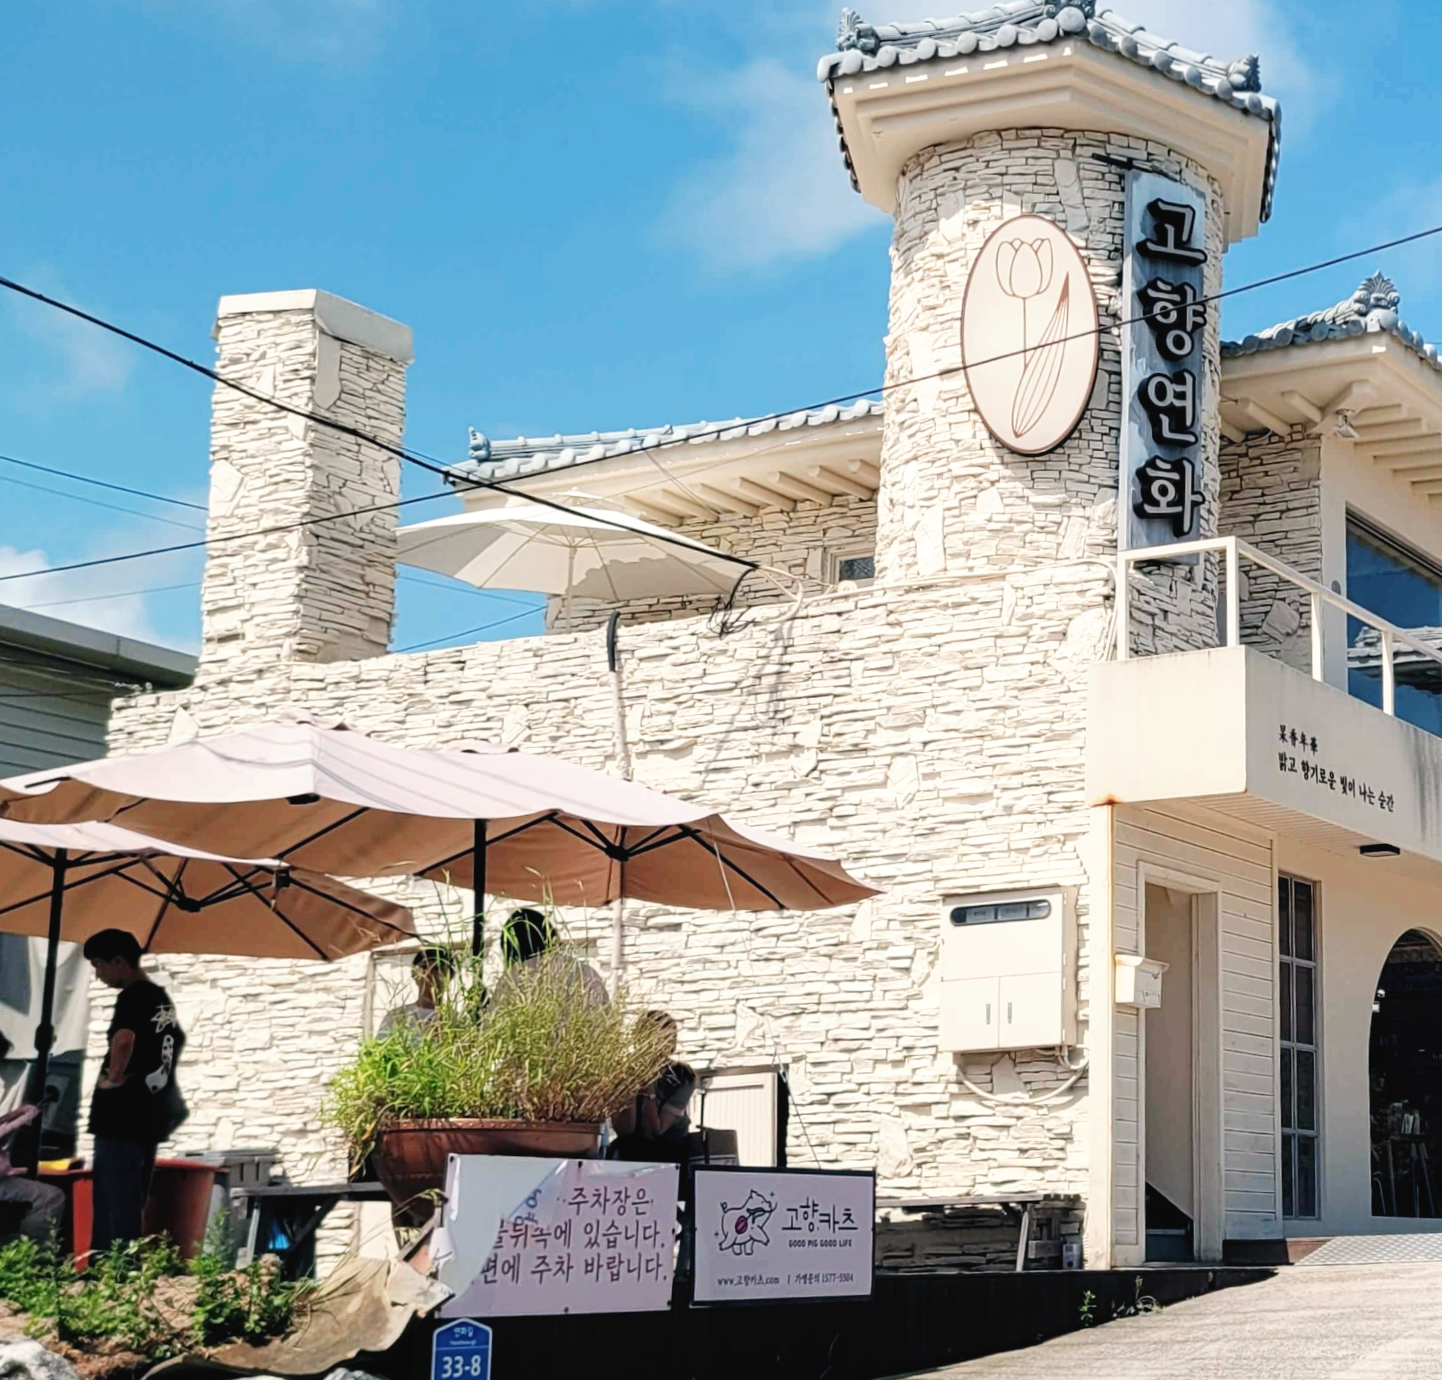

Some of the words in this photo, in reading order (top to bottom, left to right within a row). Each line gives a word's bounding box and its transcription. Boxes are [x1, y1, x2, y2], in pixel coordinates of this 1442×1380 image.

[1136, 196, 1208, 537] 고향연화
[1278, 751, 1298, 773] 밝고
[1301, 759, 1337, 790] 향기로운
[1340, 775, 1356, 798] 빛이
[1359, 782, 1376, 806] 나는
[1378, 790, 1395, 813] 순간
[568, 1186, 650, 1216] 주차장은
[583, 1218, 665, 1249] 있습니다.
[788, 1239, 806, 1248] GOOD
[807, 1239, 818, 1248] PIG
[820, 1239, 837, 1248] GOOD
[839, 1239, 852, 1248] LIFE
[531, 1253, 574, 1285] 주차
[583, 1252, 668, 1284] 바랍니다.
[441, 1354, 481, 1379] 33-8
